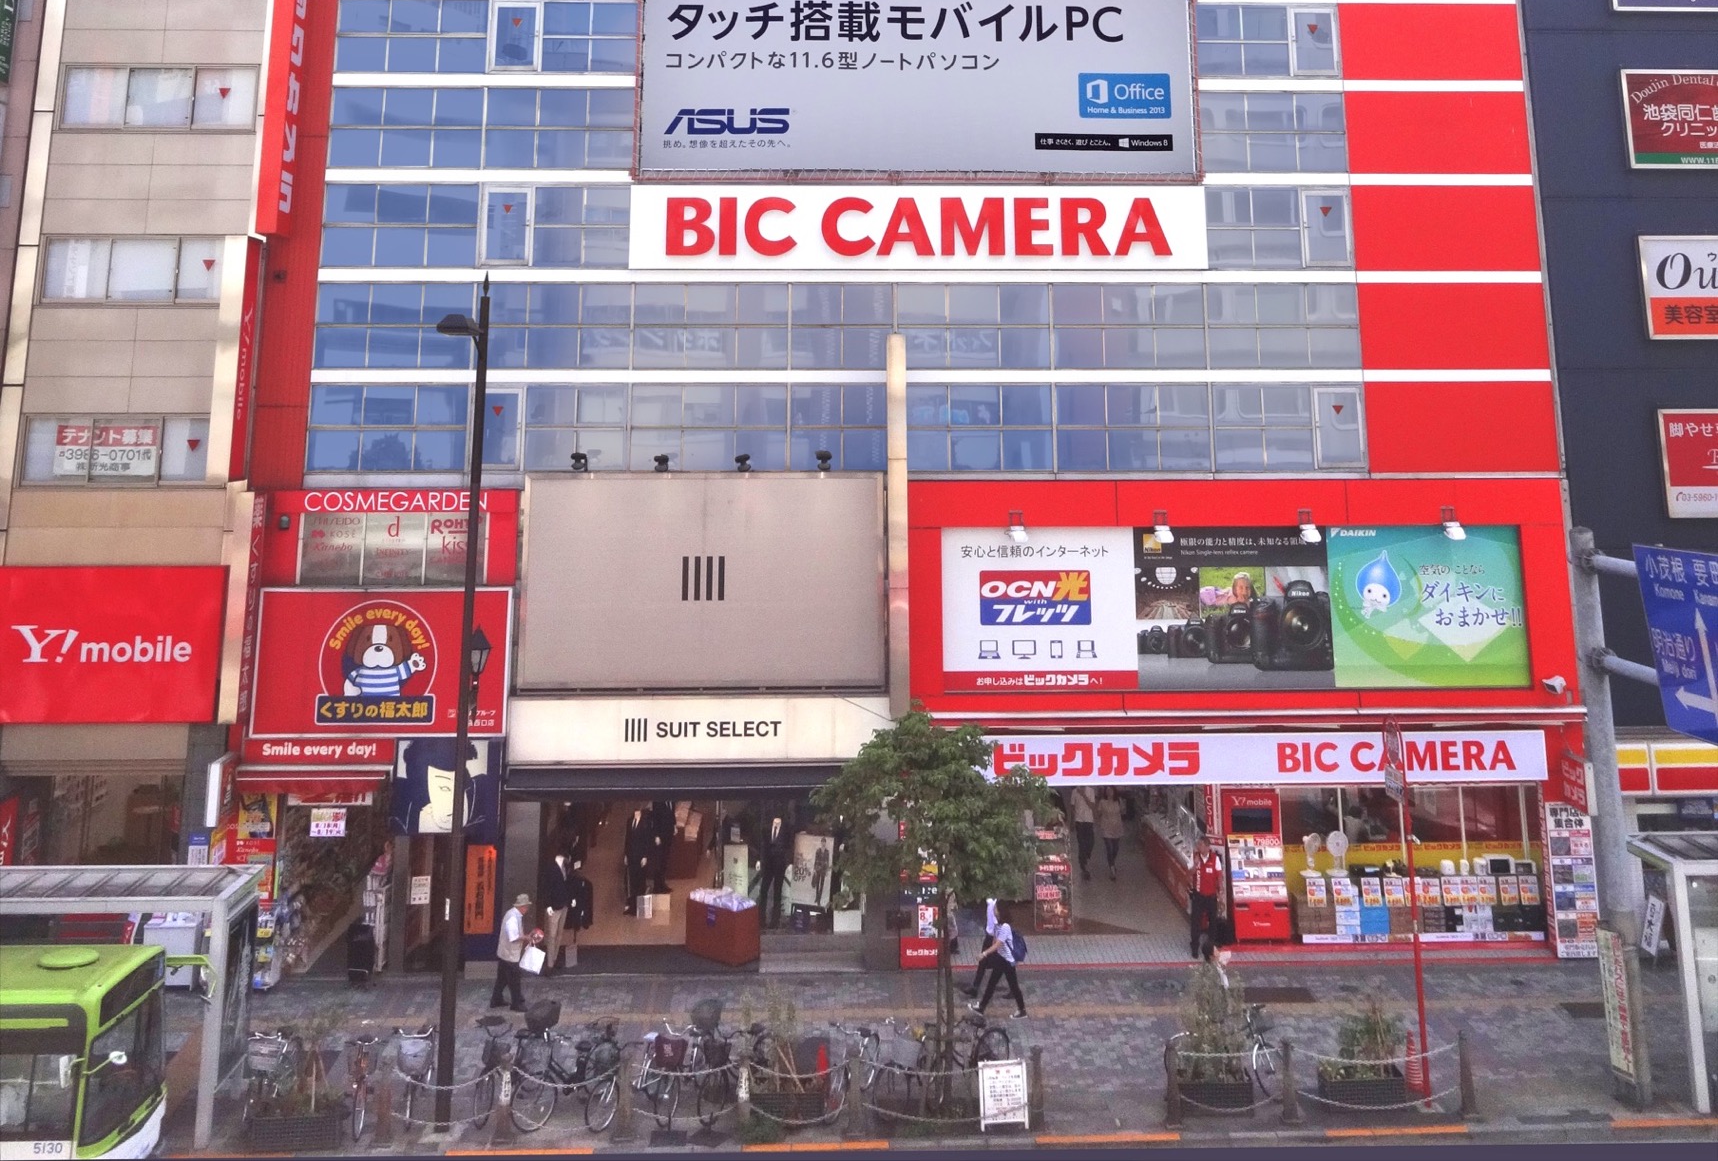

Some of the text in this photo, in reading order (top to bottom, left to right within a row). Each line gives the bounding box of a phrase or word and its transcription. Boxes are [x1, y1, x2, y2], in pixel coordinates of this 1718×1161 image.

[666, 0, 1125, 43] タッチ搭載モバイルPC
[665, 50, 1000, 72] コンパクトな11.6型ノートパソコン
[1114, 83, 1164, 100] Office
[1630, 73, 1714, 104] Doujin Dental
[1087, 106, 1165, 114] Home & Business 2013
[664, 107, 790, 136] ASUS
[663, 139, 791, 149] 挑め。想像を超えたその先へ。
[1131, 139, 1163, 147] Windows
[665, 196, 1174, 257] BIC CAMERA
[61, 428, 154, 445] テナント募集
[1669, 422, 1718, 437] 脚やせ
[1340, 529, 1377, 537] DAIKIN
[960, 544, 1109, 558] 安心と信頼のインターネット
[1419, 564, 1450, 576] 空気の
[1645, 554, 1687, 583] 小茂根
[980, 571, 1089, 601] OCN光
[1420, 581, 1505, 603] ダイキンに
[992, 604, 1080, 623] フレッツ
[1435, 606, 1523, 628] おまかせ!!
[329, 608, 430, 650] Smile every day!
[1651, 627, 1696, 662] 明治通り
[976, 673, 1103, 687] お申し込みはビックカメラへ!
[320, 701, 428, 718] くすりの福太郎
[656, 721, 782, 738] SUIT SELECT
[262, 742, 377, 758] Smile every day!
[1277, 741, 1339, 773] BIC
[993, 742, 1200, 777] ビックカメラ
[33, 1143, 63, 1155] 5130
